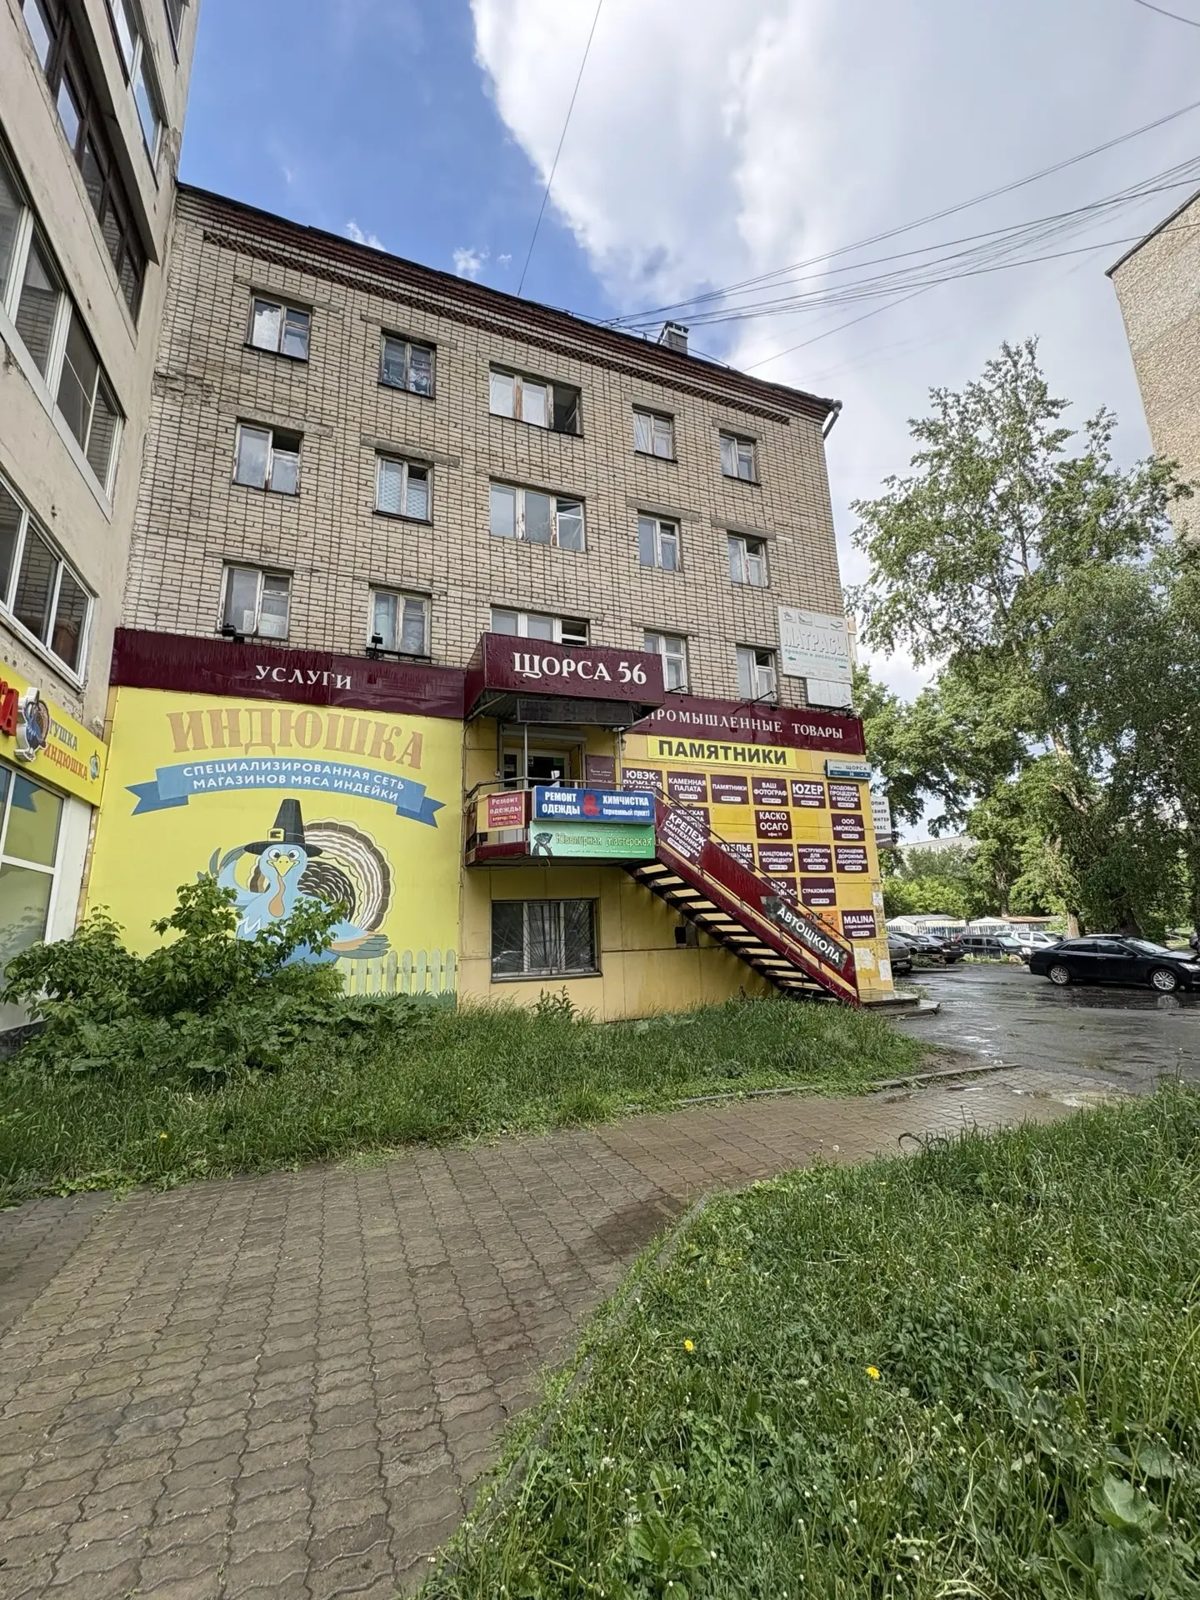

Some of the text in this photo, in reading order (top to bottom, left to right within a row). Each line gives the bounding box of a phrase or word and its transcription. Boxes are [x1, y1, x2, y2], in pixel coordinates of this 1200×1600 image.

[513, 652, 647, 685] ЩОРСА 56
[255, 665, 352, 690] УСЛУГИ
[0, 680, 19, 736] А
[166, 708, 423, 769] ИНДЮШКА
[791, 723, 843, 739] ТОВАРЫ
[658, 739, 787, 766] ПАМЯТНИКИ
[183, 761, 405, 790] СПЕЦИАЛИЗИРОВАННАЯ СЕТЬ
[626, 770, 659, 781] ЮВЭК-
[668, 777, 706, 787] КАМЕННАЯ
[193, 774, 399, 801] МАГАЗИНОВ МЯСА ИНДЕЙКИ
[674, 785, 702, 793] ПАЛАТА
[712, 783, 747, 791] ПАМЯТНИКИ
[753, 788, 787, 796] ФОТОГРАФ
[544, 791, 577, 803] РЕМОНТ
[602, 795, 649, 807] ХИМЧИСТКА
[541, 803, 581, 816] ОДЕЖДЫ
[759, 812, 786, 820] КАСКО
[668, 813, 707, 846] КРЕПЕЖ
[760, 822, 788, 831] ОСАГО
[665, 820, 701, 851] САНТЕХНИКА
[720, 844, 752, 853] АТЕЛЬЕ
[843, 915, 874, 924] MALINA
[777, 907, 841, 963] АВТОШКОЛА
